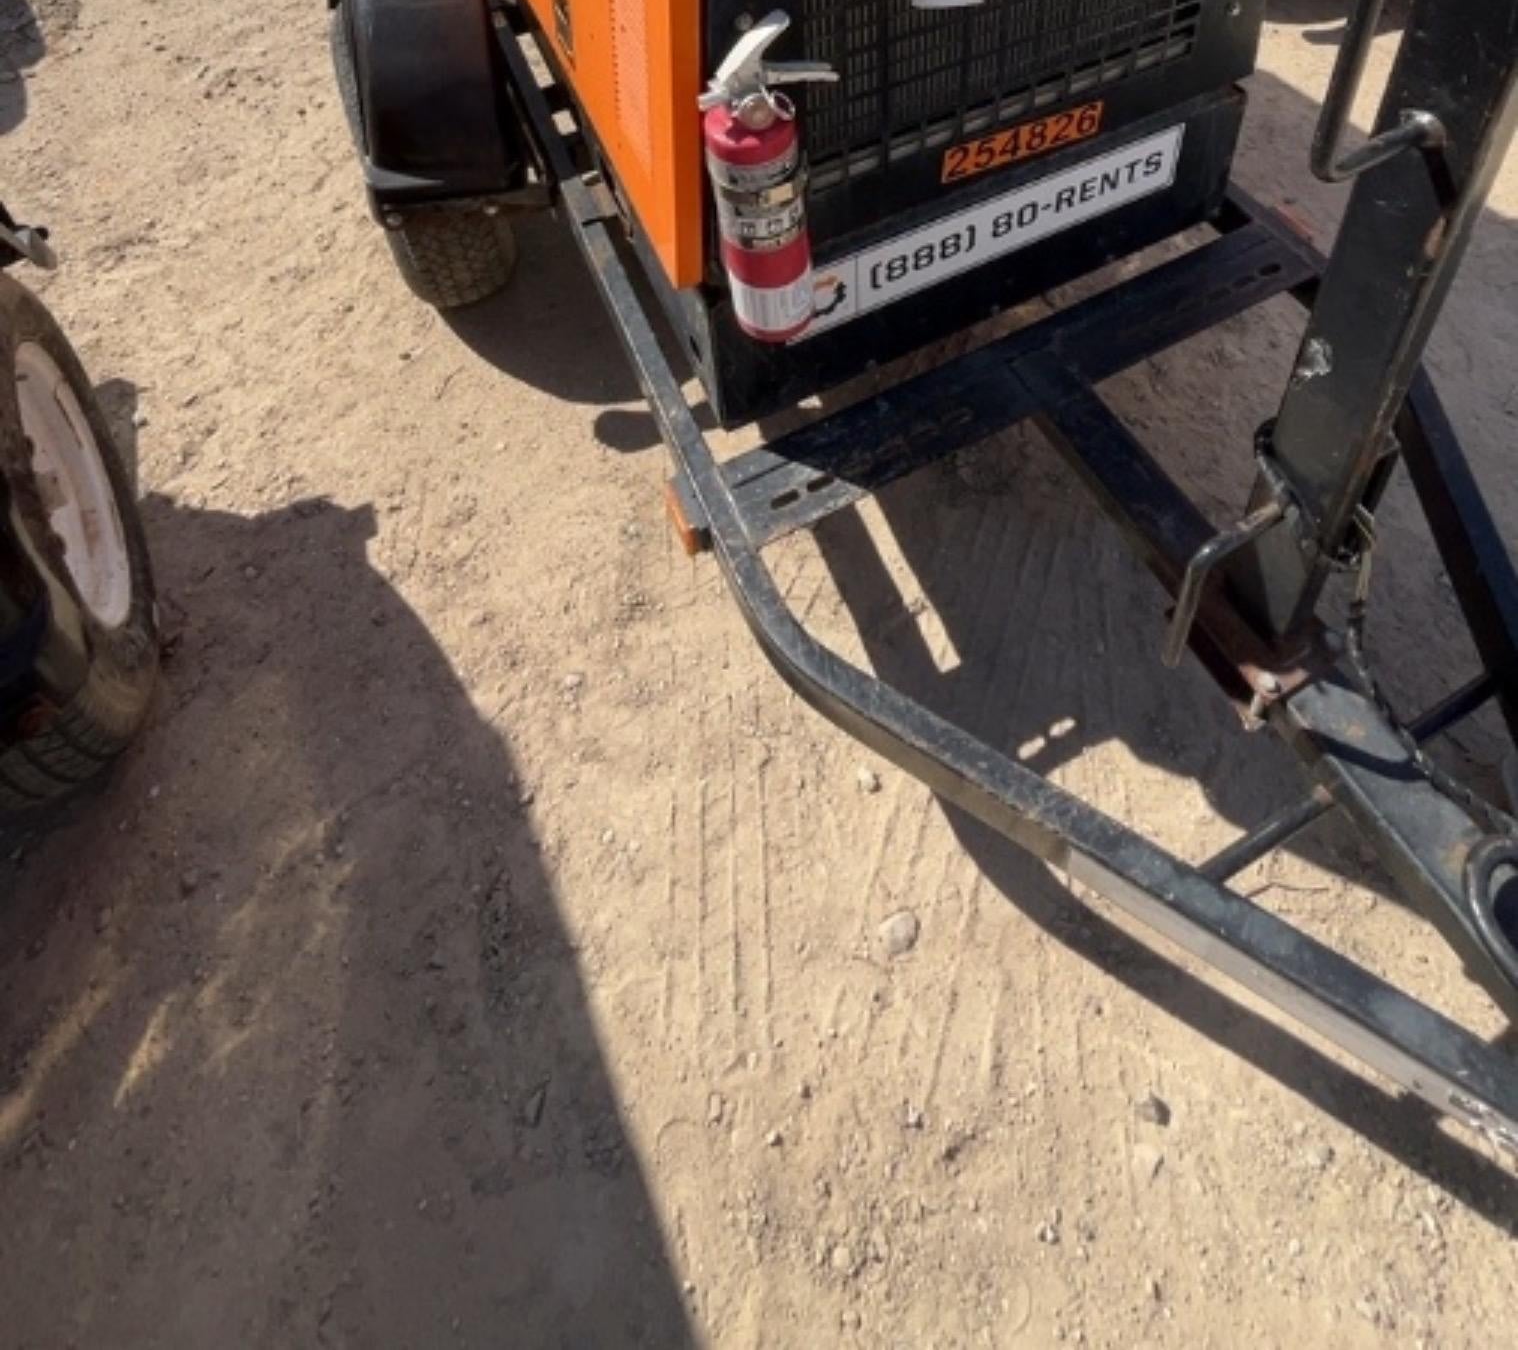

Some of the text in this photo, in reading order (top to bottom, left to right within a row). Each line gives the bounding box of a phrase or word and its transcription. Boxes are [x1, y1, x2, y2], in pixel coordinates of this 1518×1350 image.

[946, 106, 1099, 179] 254826
[869, 225, 977, 289] (888)
[991, 150, 1164, 239] 80-RENTS
